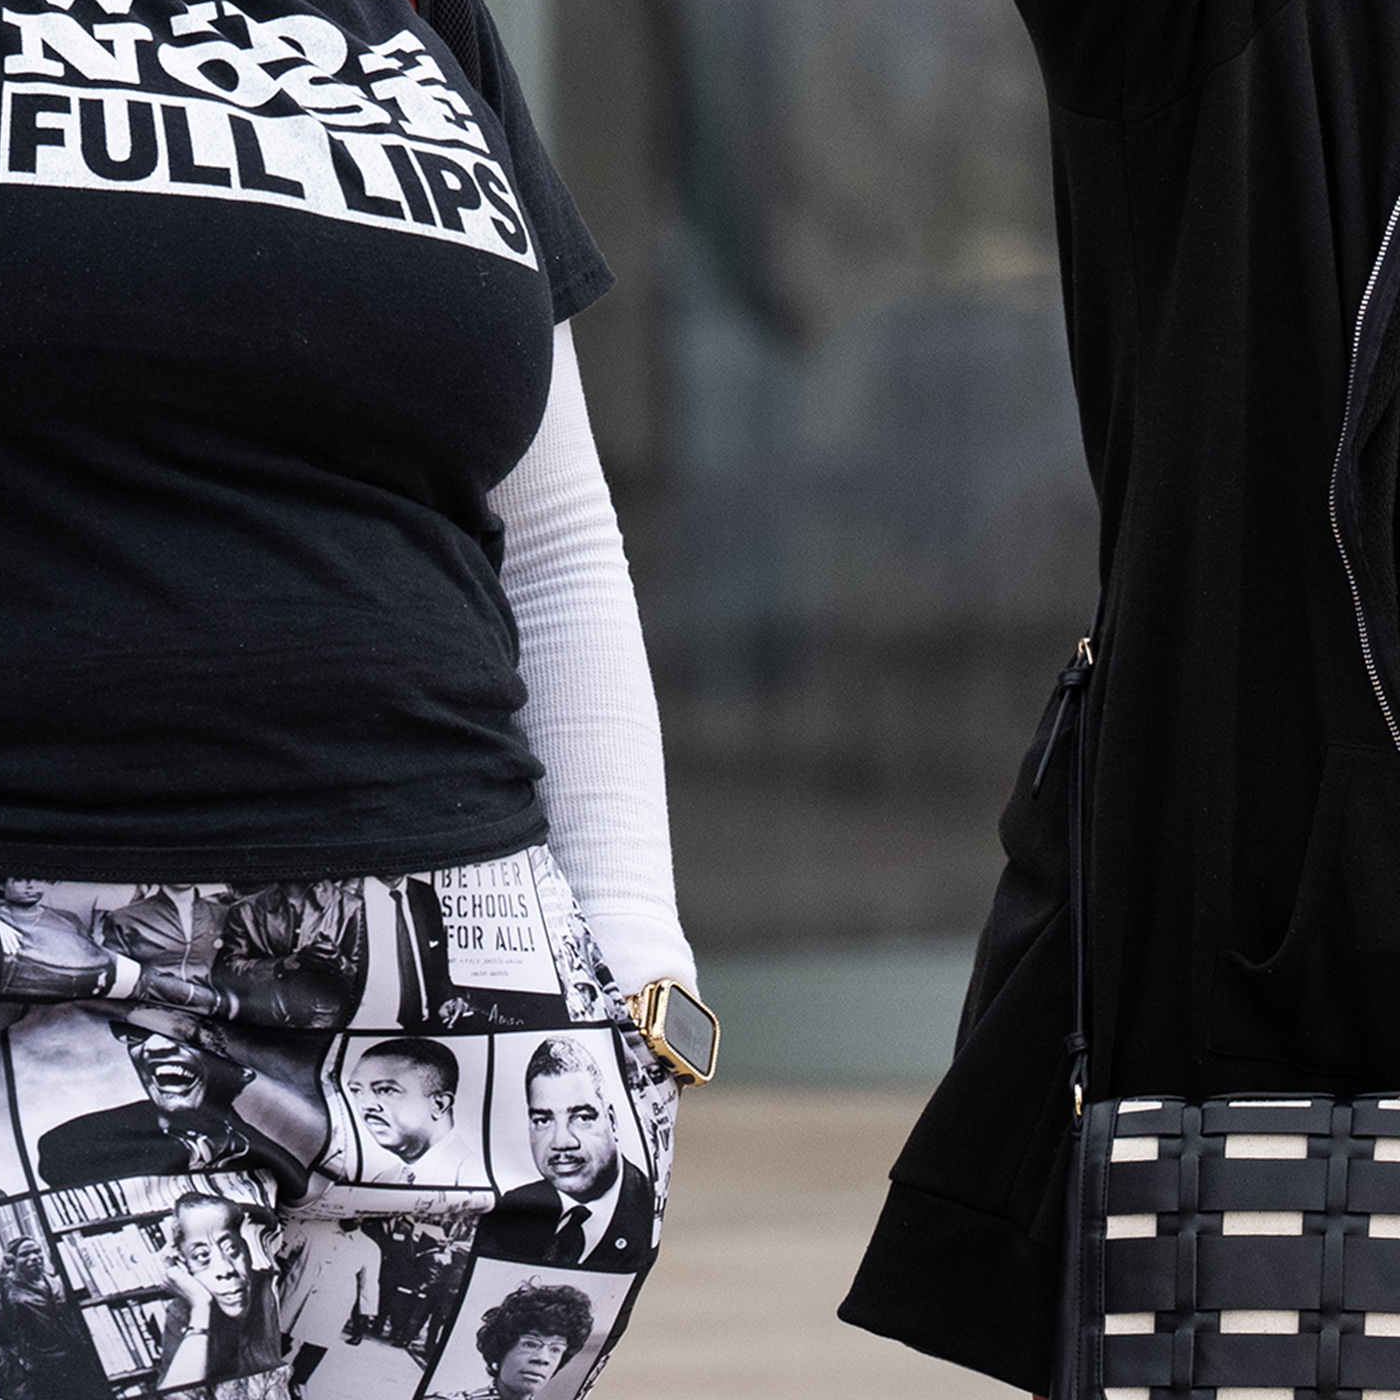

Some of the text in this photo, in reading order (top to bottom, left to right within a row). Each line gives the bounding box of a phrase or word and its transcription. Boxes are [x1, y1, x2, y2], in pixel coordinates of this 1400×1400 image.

[2, 7, 491, 154] NOSE
[8, 92, 529, 256] FULL LIPS
[441, 861, 523, 889] BETTER
[441, 893, 529, 919] SCHOOLS
[444, 924, 536, 953] FOR ALL!
